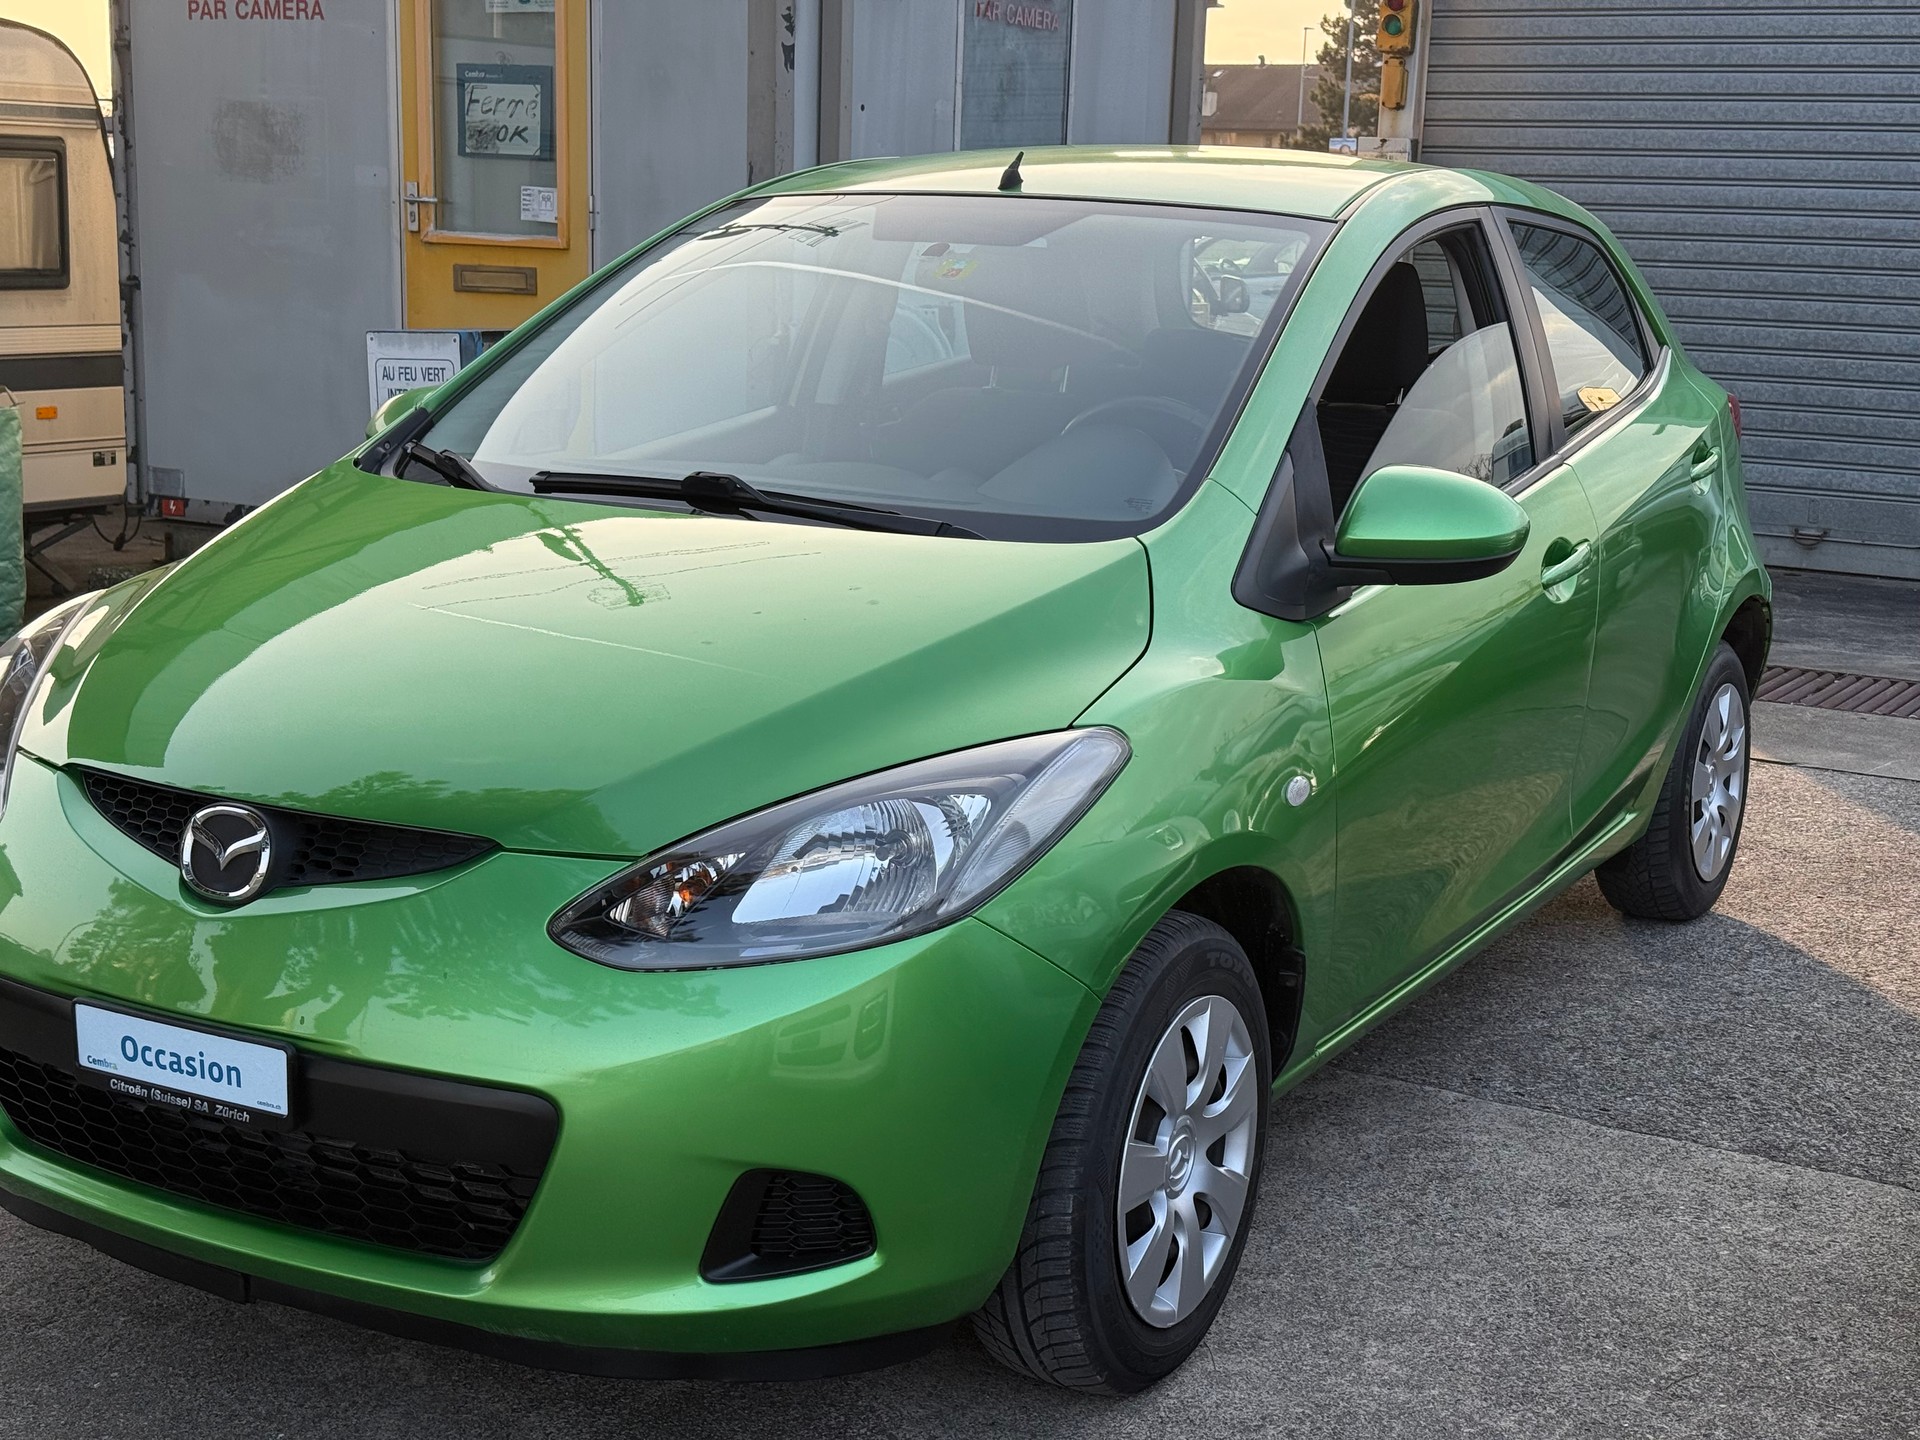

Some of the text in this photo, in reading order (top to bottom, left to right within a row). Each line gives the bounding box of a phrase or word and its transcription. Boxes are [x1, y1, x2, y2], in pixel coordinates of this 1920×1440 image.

[187, 0, 325, 20] PAR CAMERA
[1006, 4, 1060, 31] CAMERA
[382, 366, 395, 381] AU
[398, 366, 417, 382] FEU
[1206, 951, 1254, 988] TOYO
[87, 1055, 118, 1071] Cembra
[120, 1035, 242, 1088] Occasion
[110, 1078, 251, 1123] Citroën (Suisse) SA Zürich
